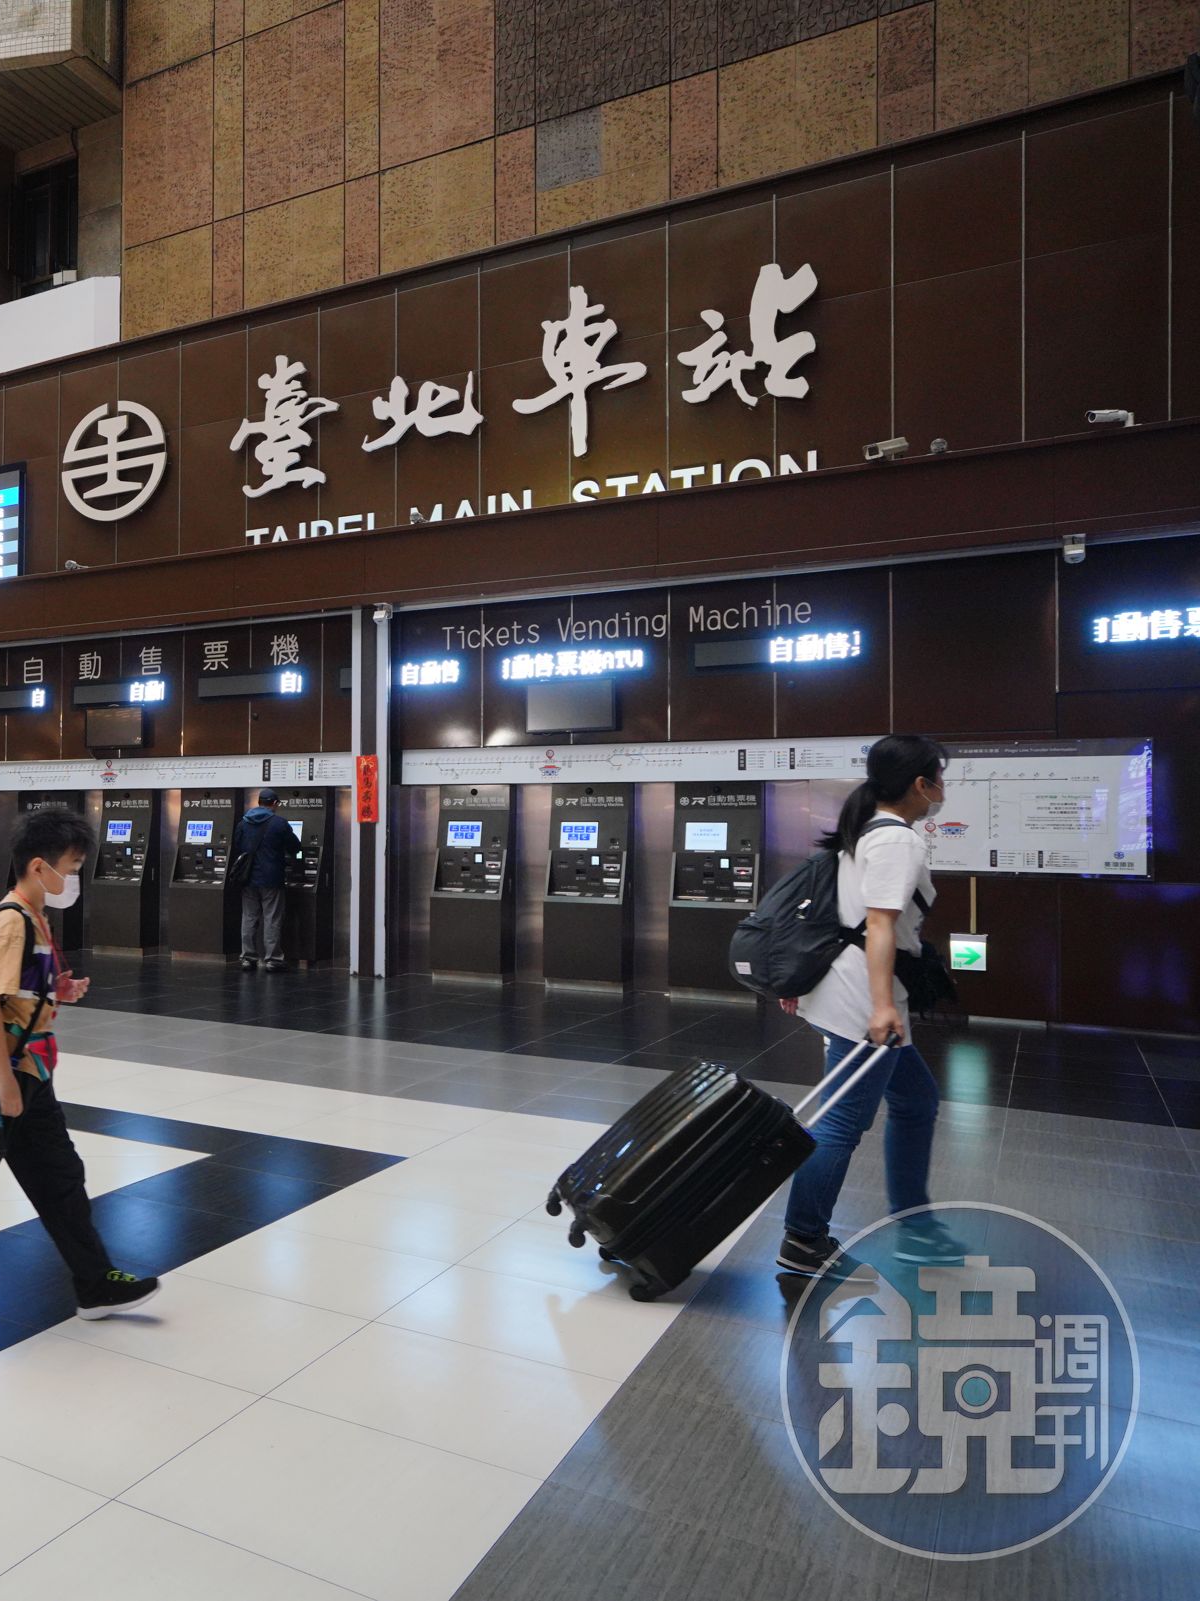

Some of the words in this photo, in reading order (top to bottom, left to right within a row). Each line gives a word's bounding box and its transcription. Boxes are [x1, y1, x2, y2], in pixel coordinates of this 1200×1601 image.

[230, 262, 818, 498] 臺北車站
[442, 621, 540, 651] Tickets
[558, 612, 668, 641] Vending
[689, 600, 812, 632] Machine
[23, 634, 299, 684] 自動售票機
[280, 671, 302, 694] 自
[401, 658, 460, 687] 自動售
[31, 688, 45, 707] 自
[129, 680, 165, 703] 自動
[707, 795, 757, 803] 自動售票機
